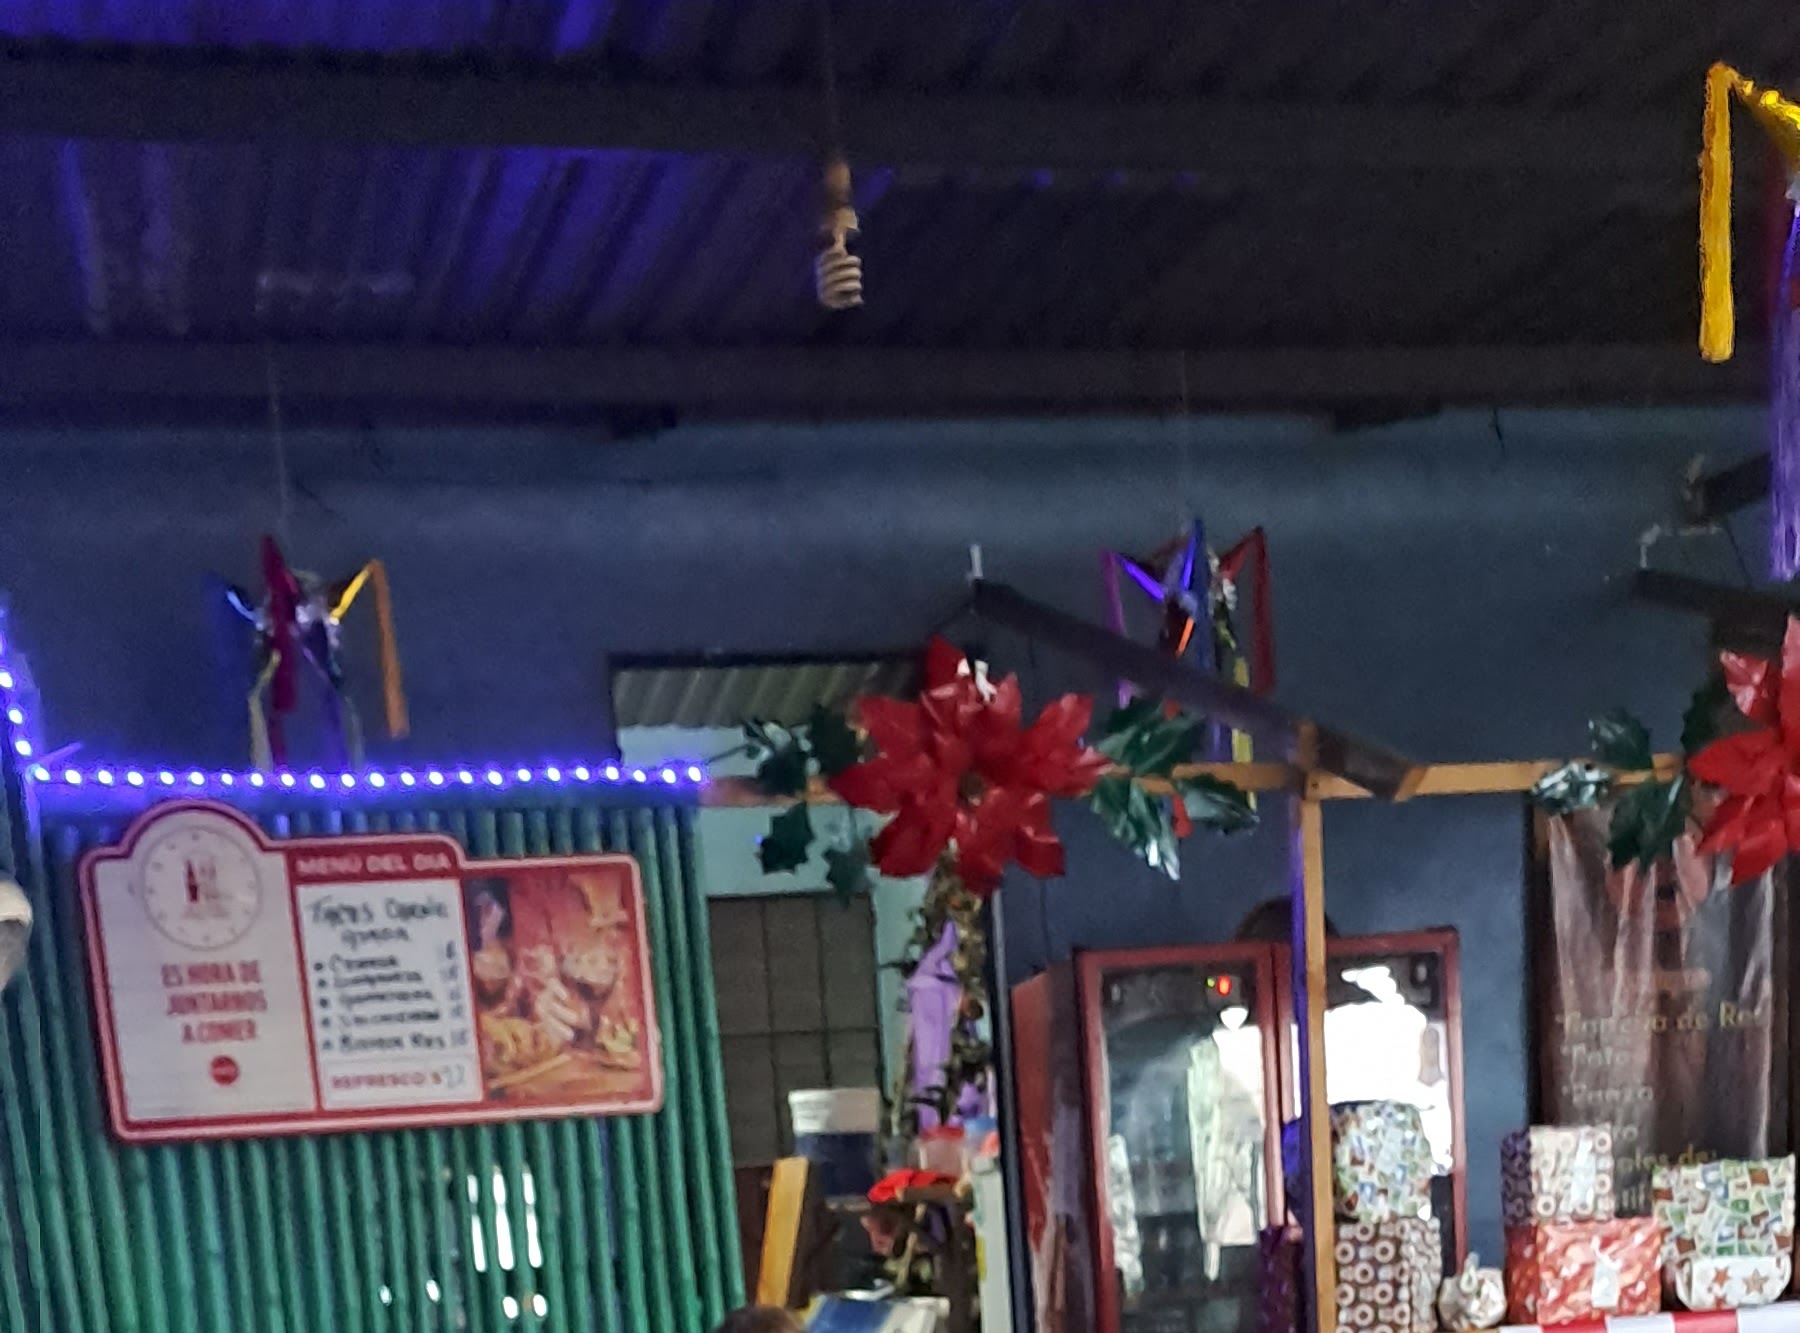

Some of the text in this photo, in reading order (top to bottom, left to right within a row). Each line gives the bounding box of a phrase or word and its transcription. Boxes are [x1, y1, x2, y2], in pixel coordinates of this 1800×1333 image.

[366, 855, 408, 873] DEL
[162, 960, 262, 987] ES HORA DE
[167, 990, 268, 1015] JUNTARNOS
[182, 1019, 257, 1043] A COMER
[332, 1071, 426, 1089] REFRESCO
